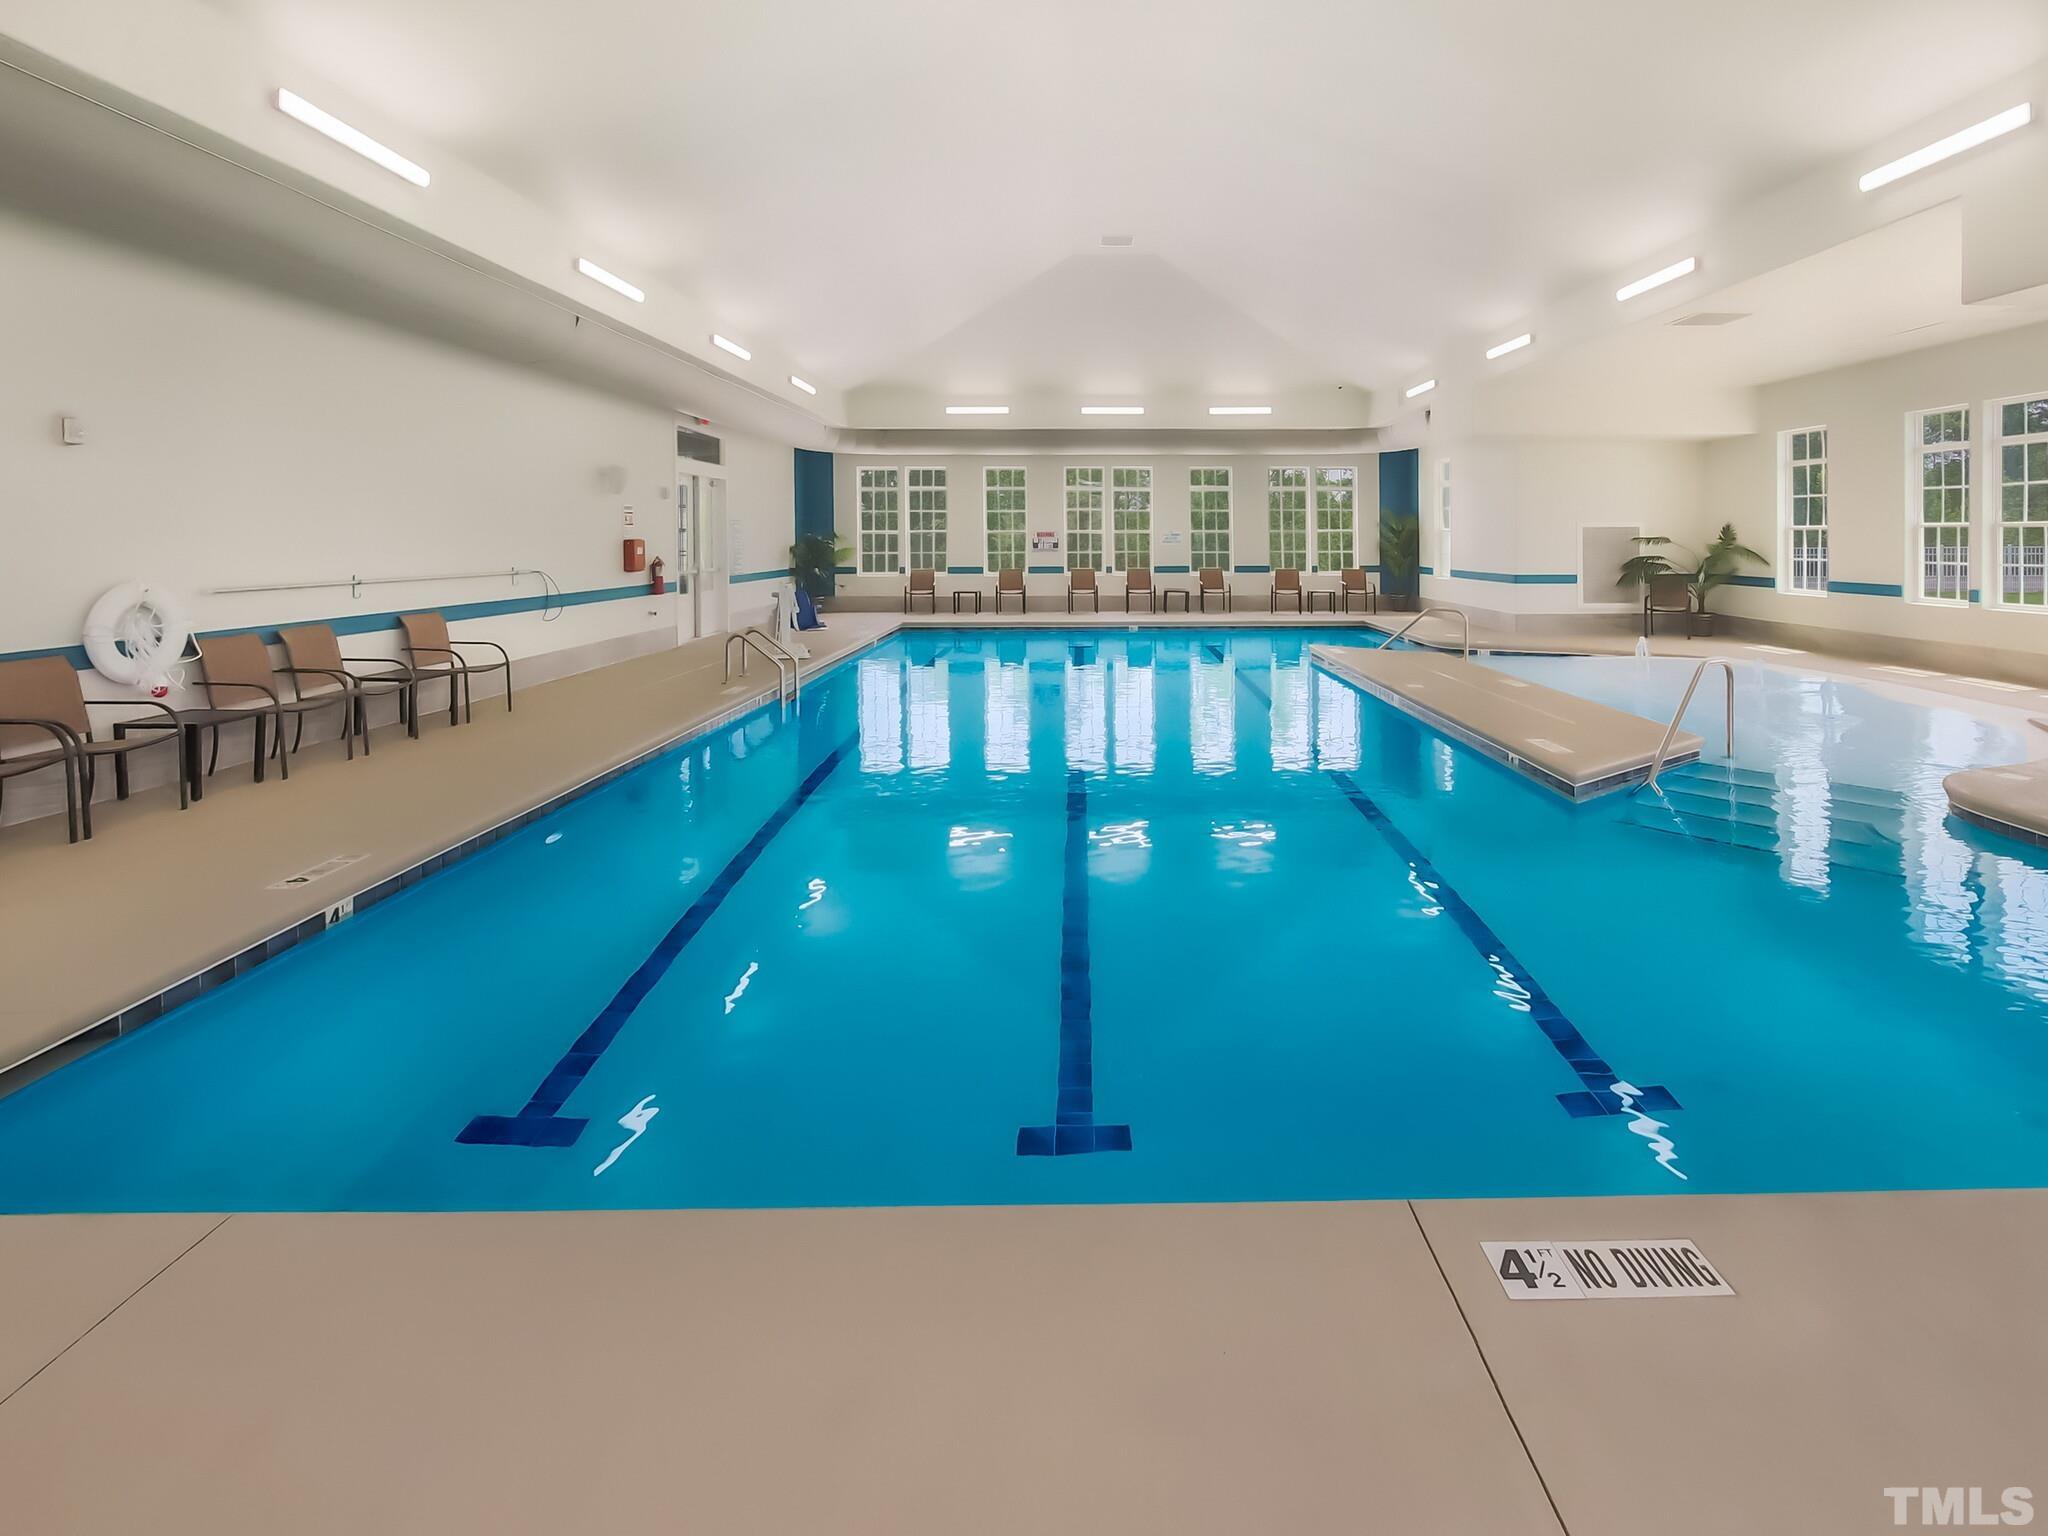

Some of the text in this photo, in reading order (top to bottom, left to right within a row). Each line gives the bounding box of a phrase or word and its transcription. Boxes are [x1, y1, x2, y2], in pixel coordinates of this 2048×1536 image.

[1537, 1248, 1553, 1258] FT
[1562, 1248, 1617, 1289] NO
[1609, 1247, 1721, 1288] DIVING
